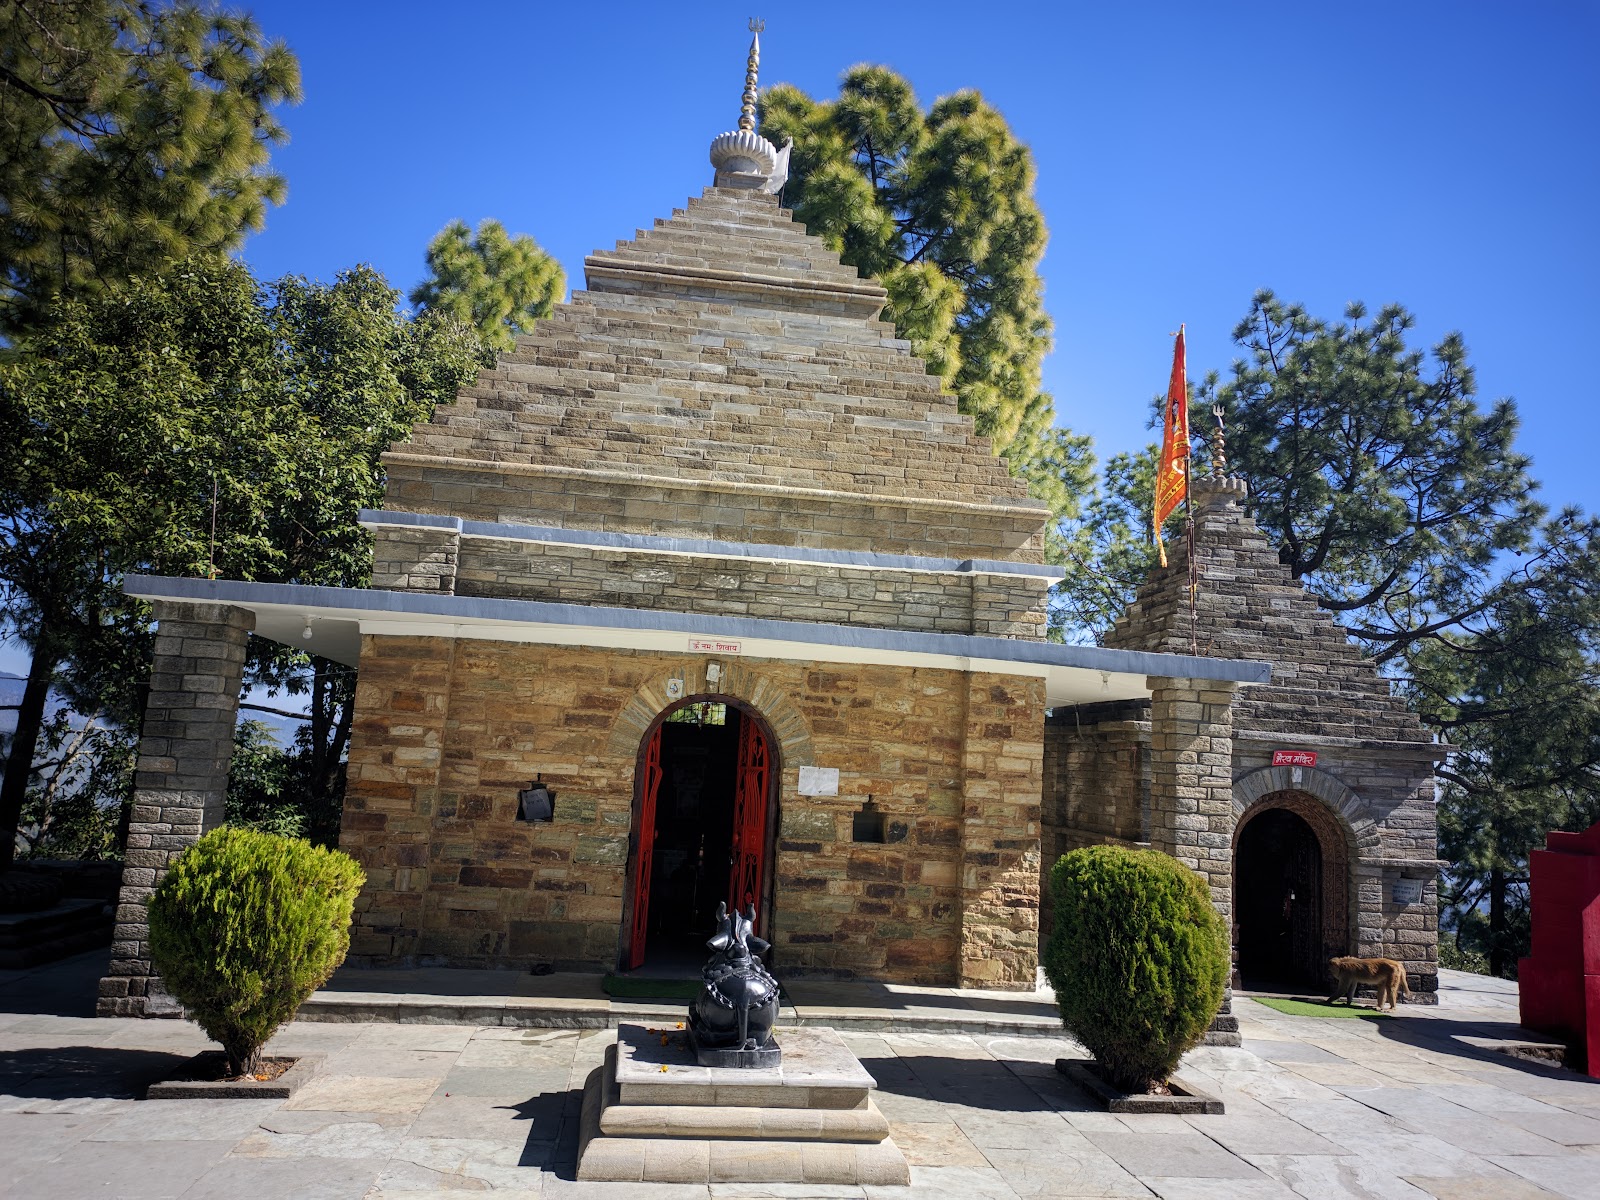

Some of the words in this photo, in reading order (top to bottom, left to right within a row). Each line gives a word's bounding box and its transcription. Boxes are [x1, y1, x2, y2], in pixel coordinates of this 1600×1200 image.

[716, 642, 738, 652] शिवाय
[1275, 752, 1293, 764] भैरव
[1293, 752, 1314, 765] मंदिर
